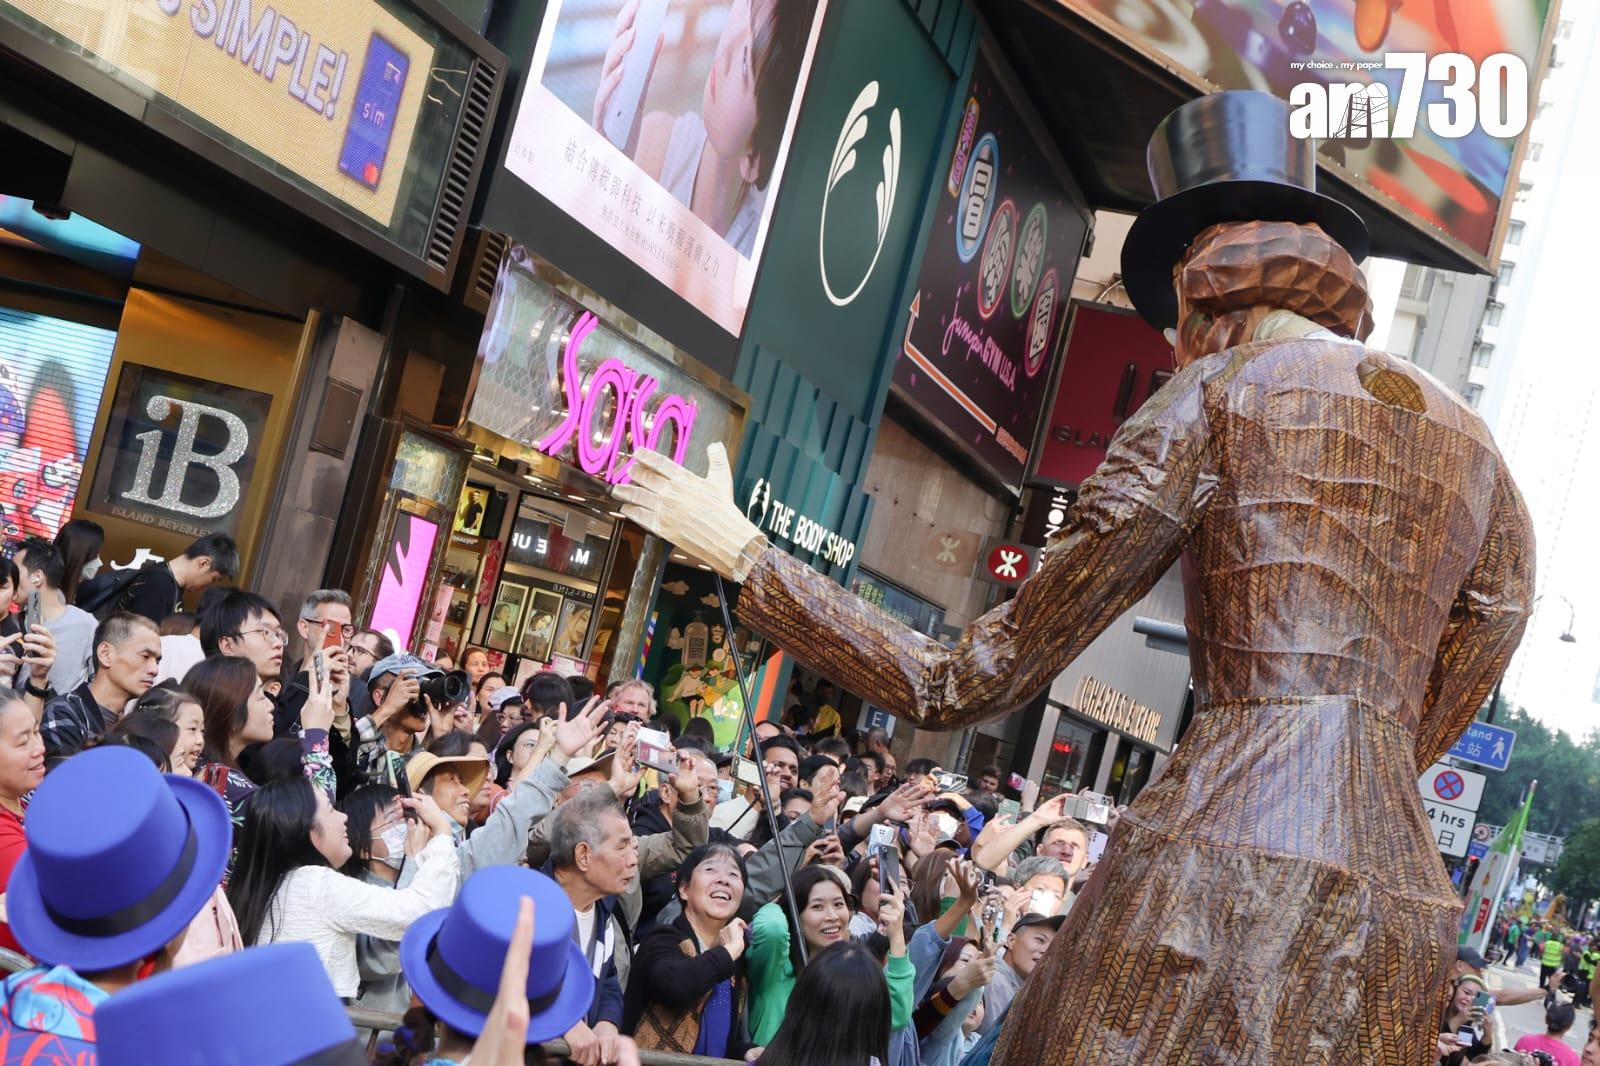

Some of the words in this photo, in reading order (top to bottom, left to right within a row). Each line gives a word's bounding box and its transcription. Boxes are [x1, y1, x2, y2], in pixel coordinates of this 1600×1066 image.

[111, 506, 154, 525] ISLAND
[769, 500, 795, 539] THE
[793, 514, 828, 556] BODY
[821, 531, 855, 569] SHOP
[871, 710, 883, 727] E
[1466, 725, 1493, 741] tand
[1450, 740, 1482, 758] 士站
[1427, 807, 1436, 820] 4
[1440, 810, 1466, 829] hrs
